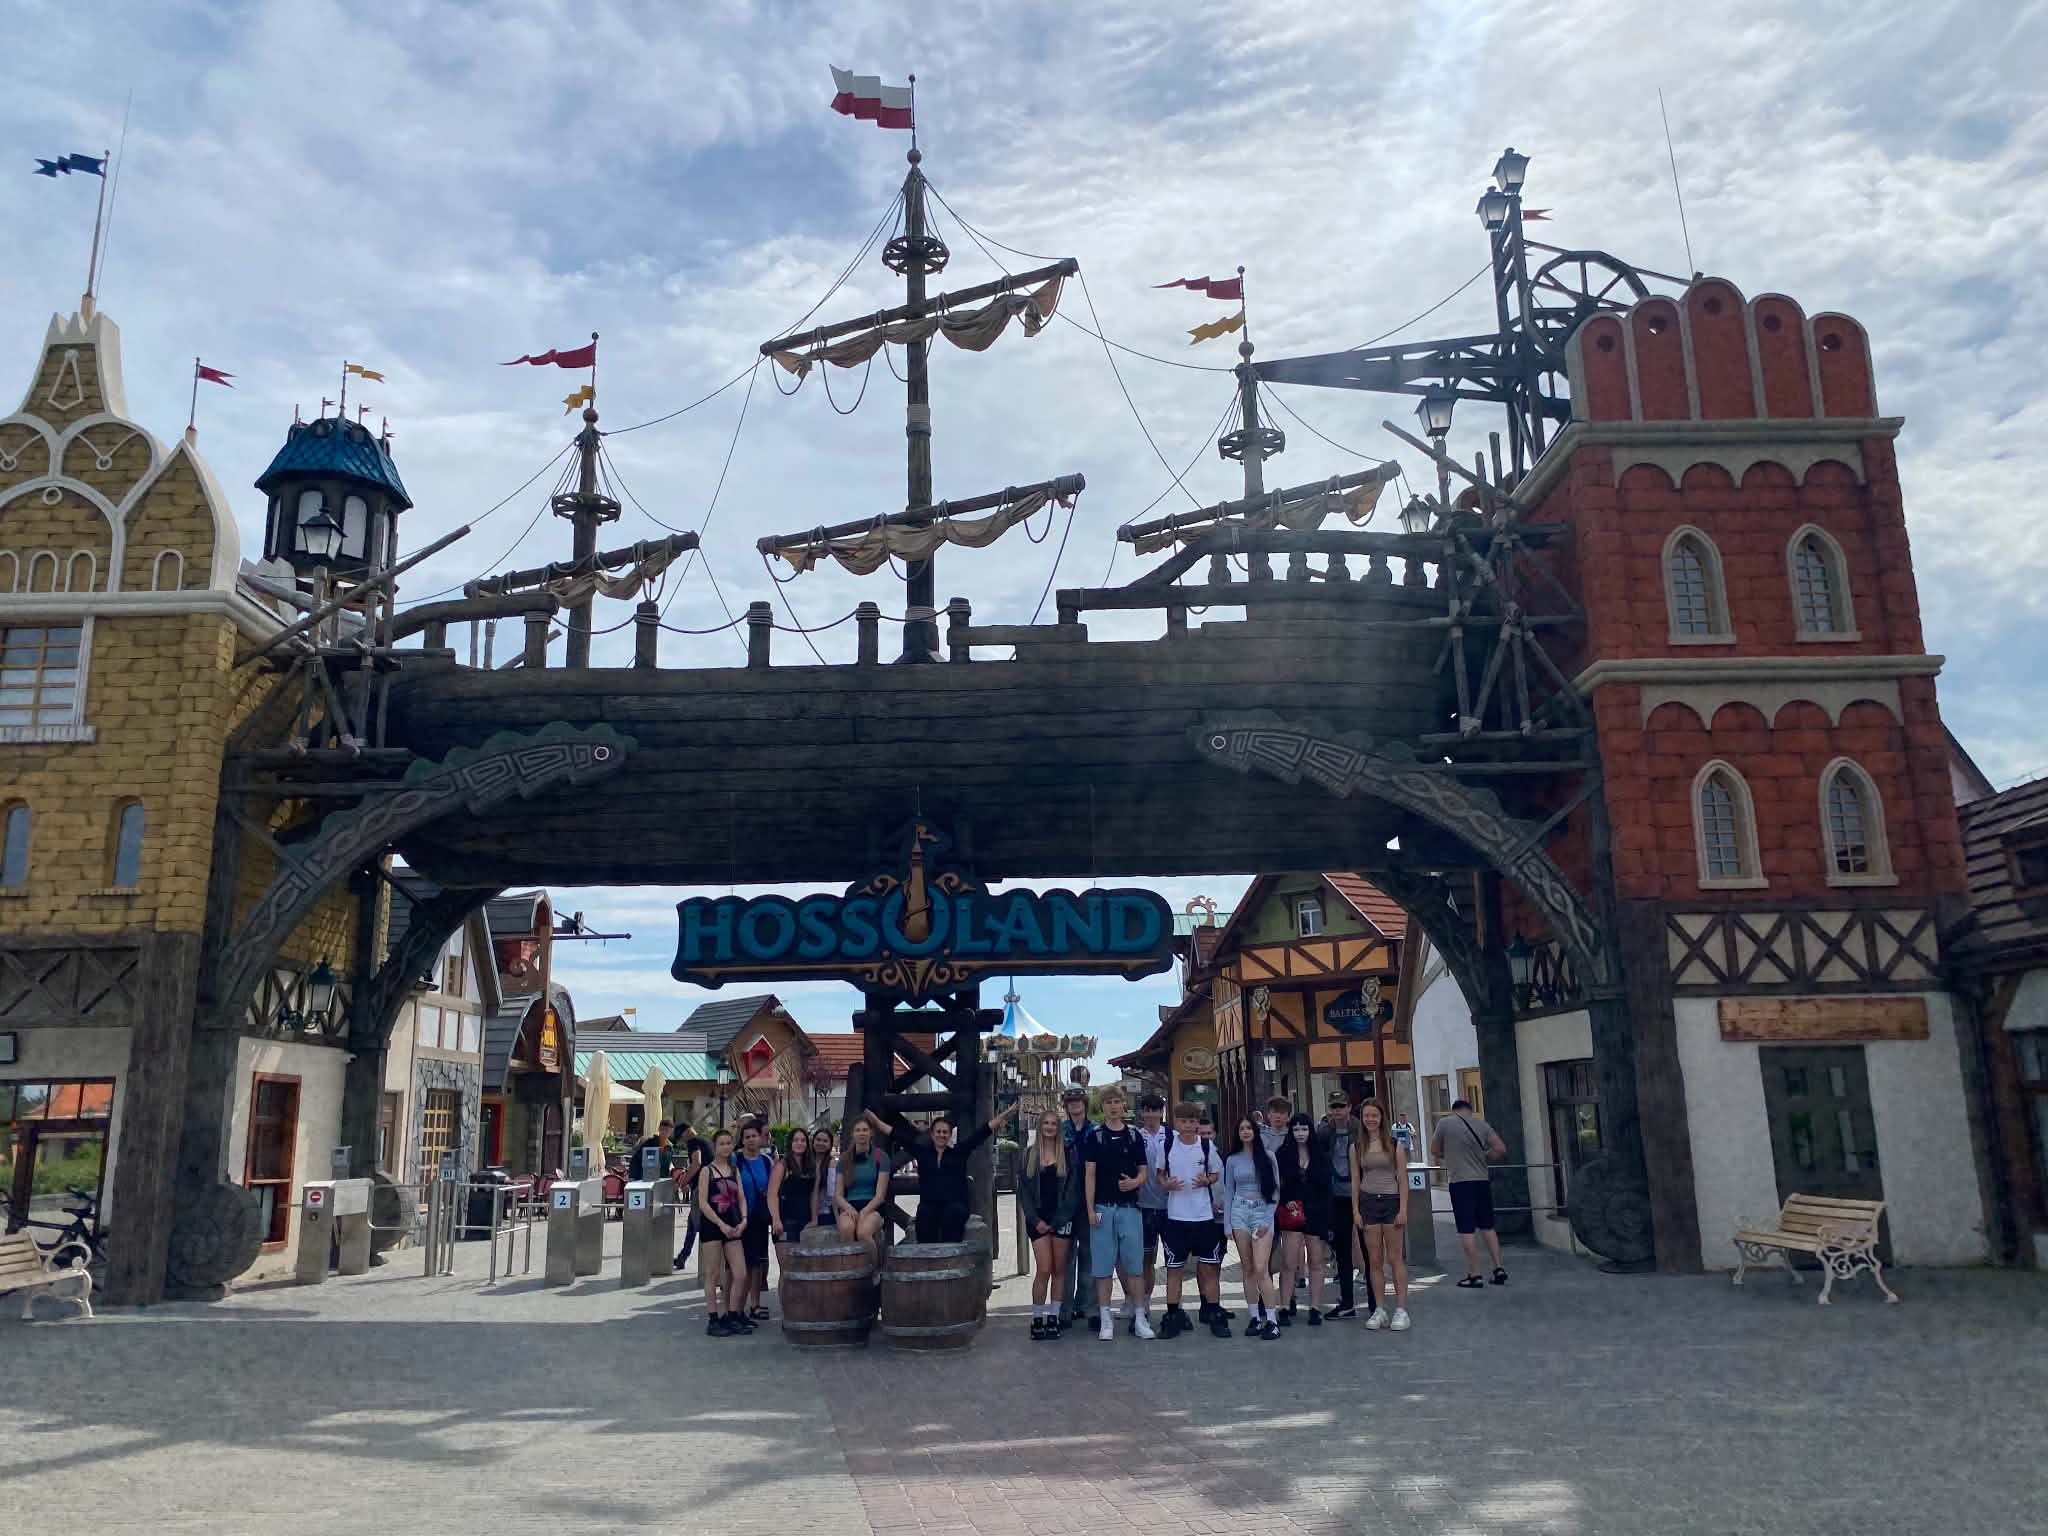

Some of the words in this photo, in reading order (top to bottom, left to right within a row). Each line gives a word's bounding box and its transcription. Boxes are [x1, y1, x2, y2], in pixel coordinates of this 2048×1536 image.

[681, 886, 1162, 961] HOSSOLAND
[1329, 1007, 1360, 1018] BALTIC
[1413, 1175, 1422, 1186] 8
[559, 1195, 567, 1206] 2
